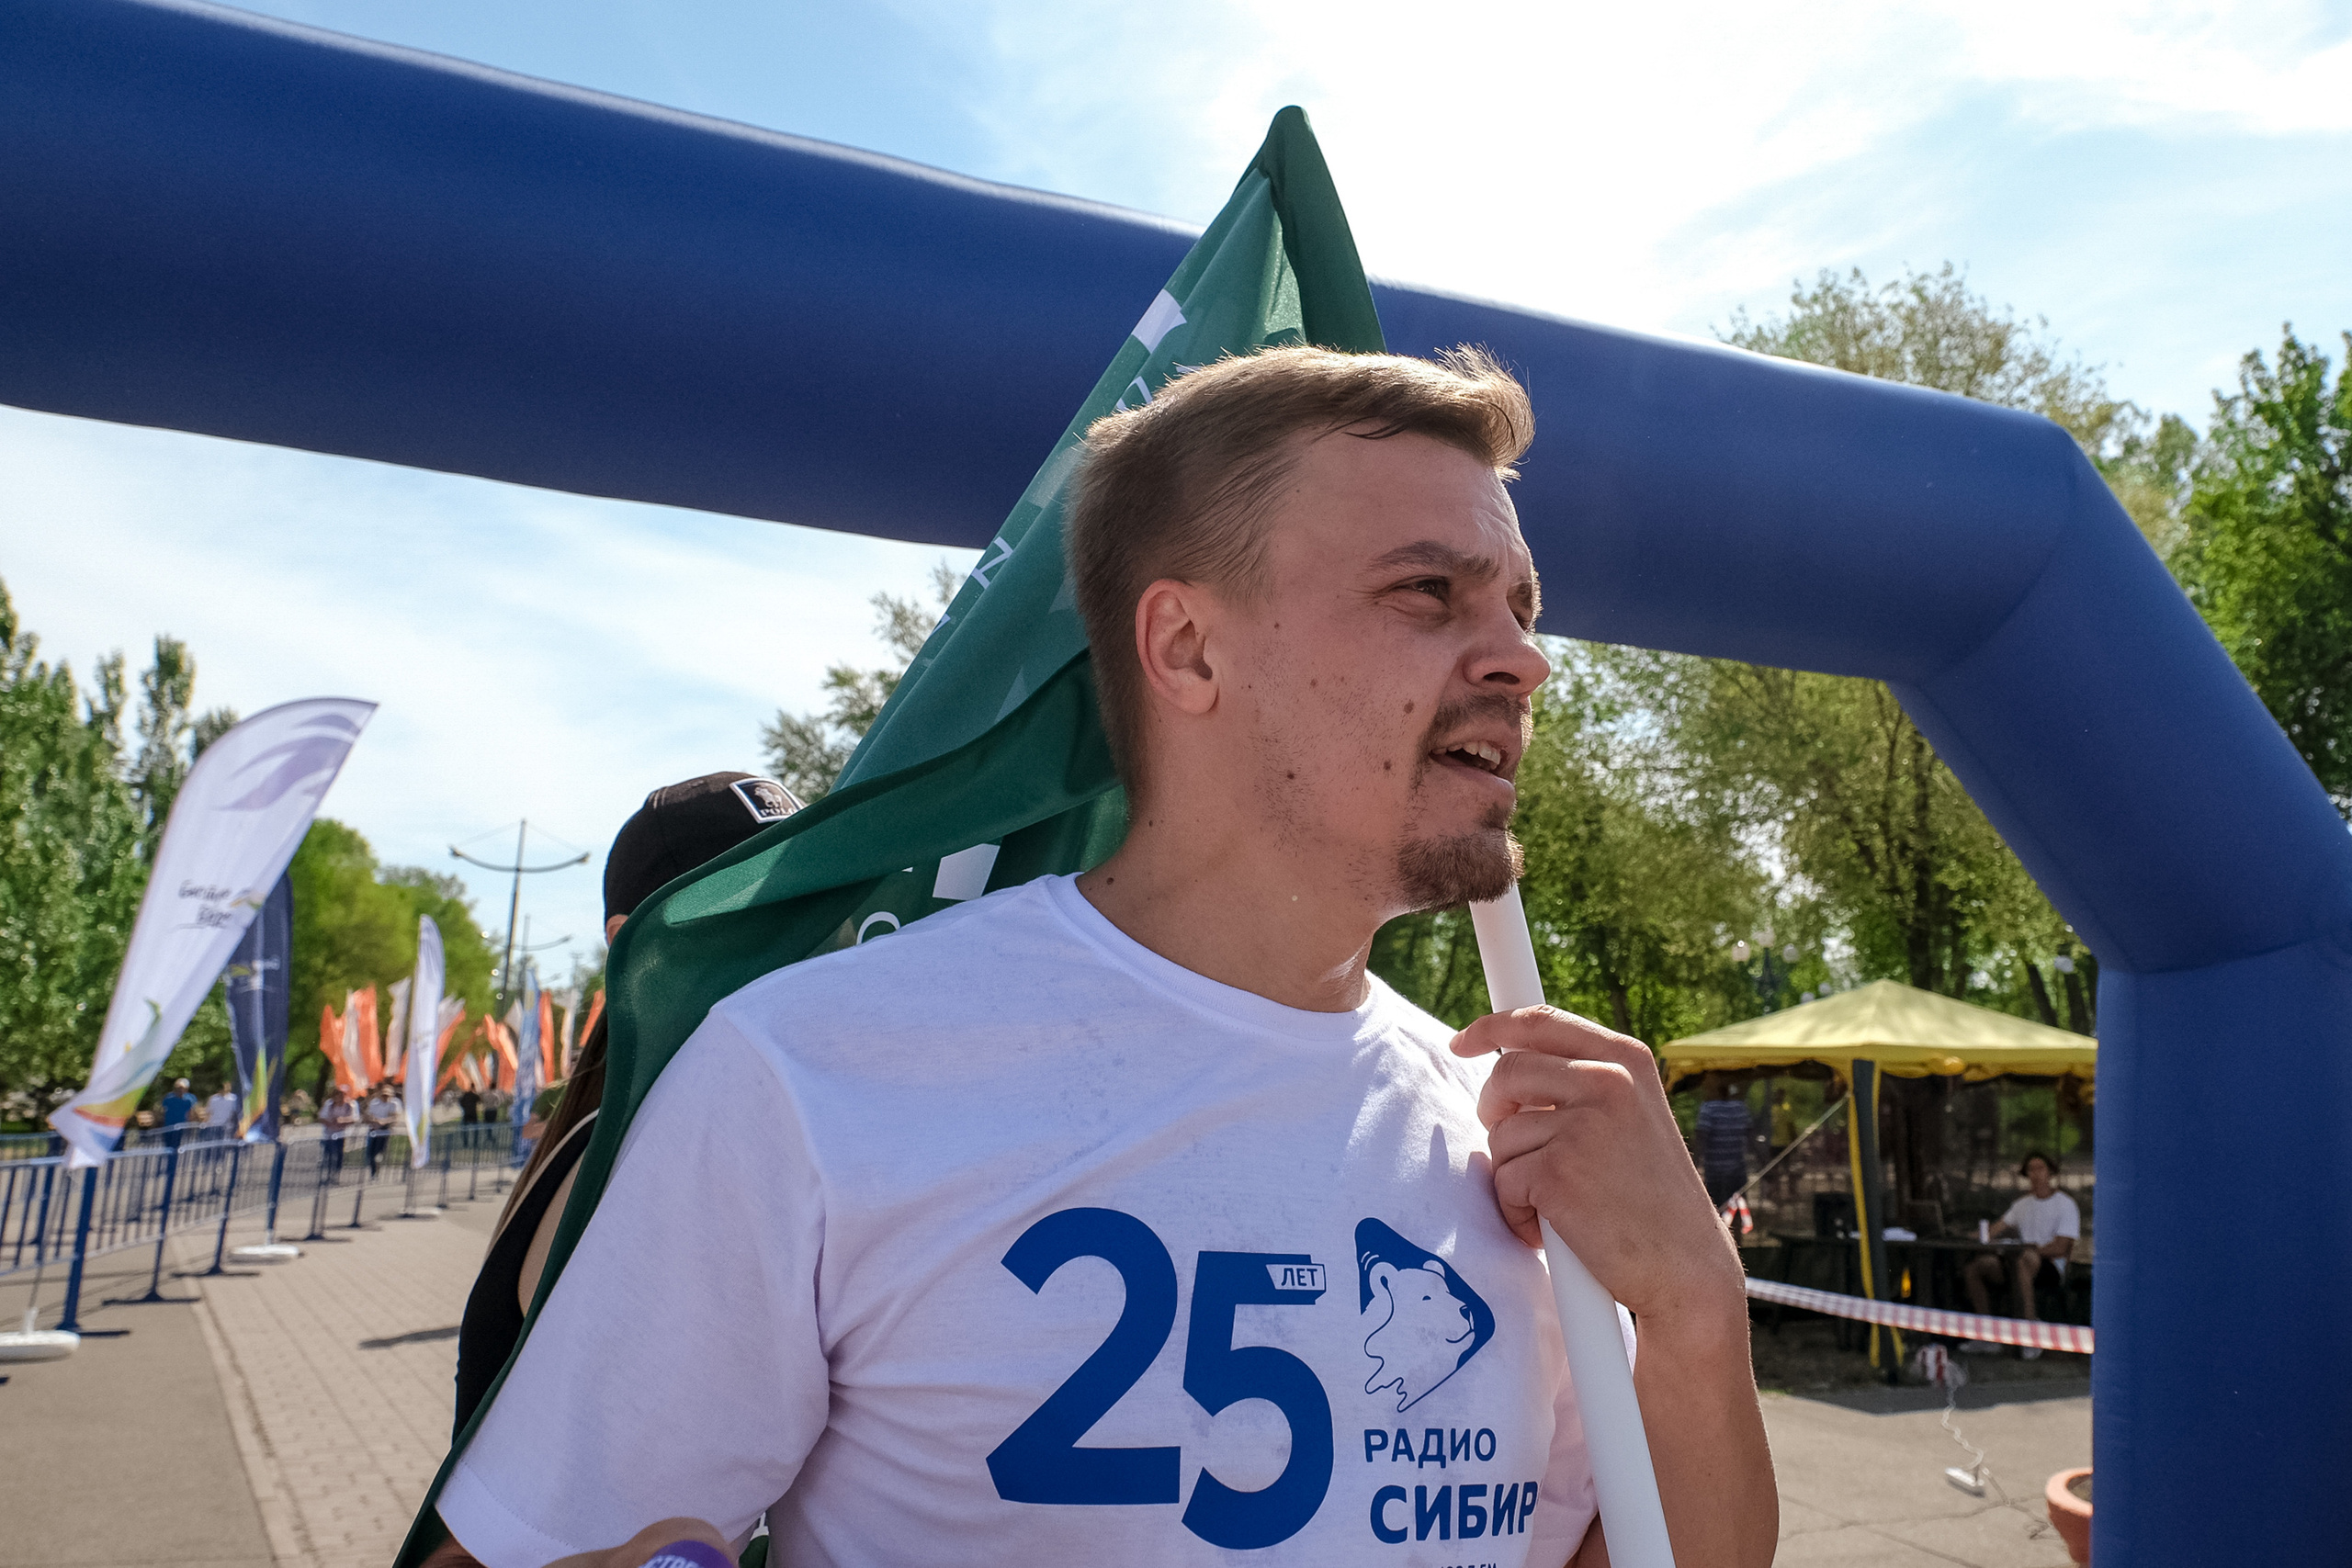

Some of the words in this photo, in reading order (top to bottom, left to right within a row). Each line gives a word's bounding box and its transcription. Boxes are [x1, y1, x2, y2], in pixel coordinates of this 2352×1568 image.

[986, 1207, 1334, 1551] 25
[1281, 1267, 1317, 1287] ЛЕТ
[1363, 1427, 1497, 1469] РАДИО
[1369, 1481, 1542, 1544] СИБИР
